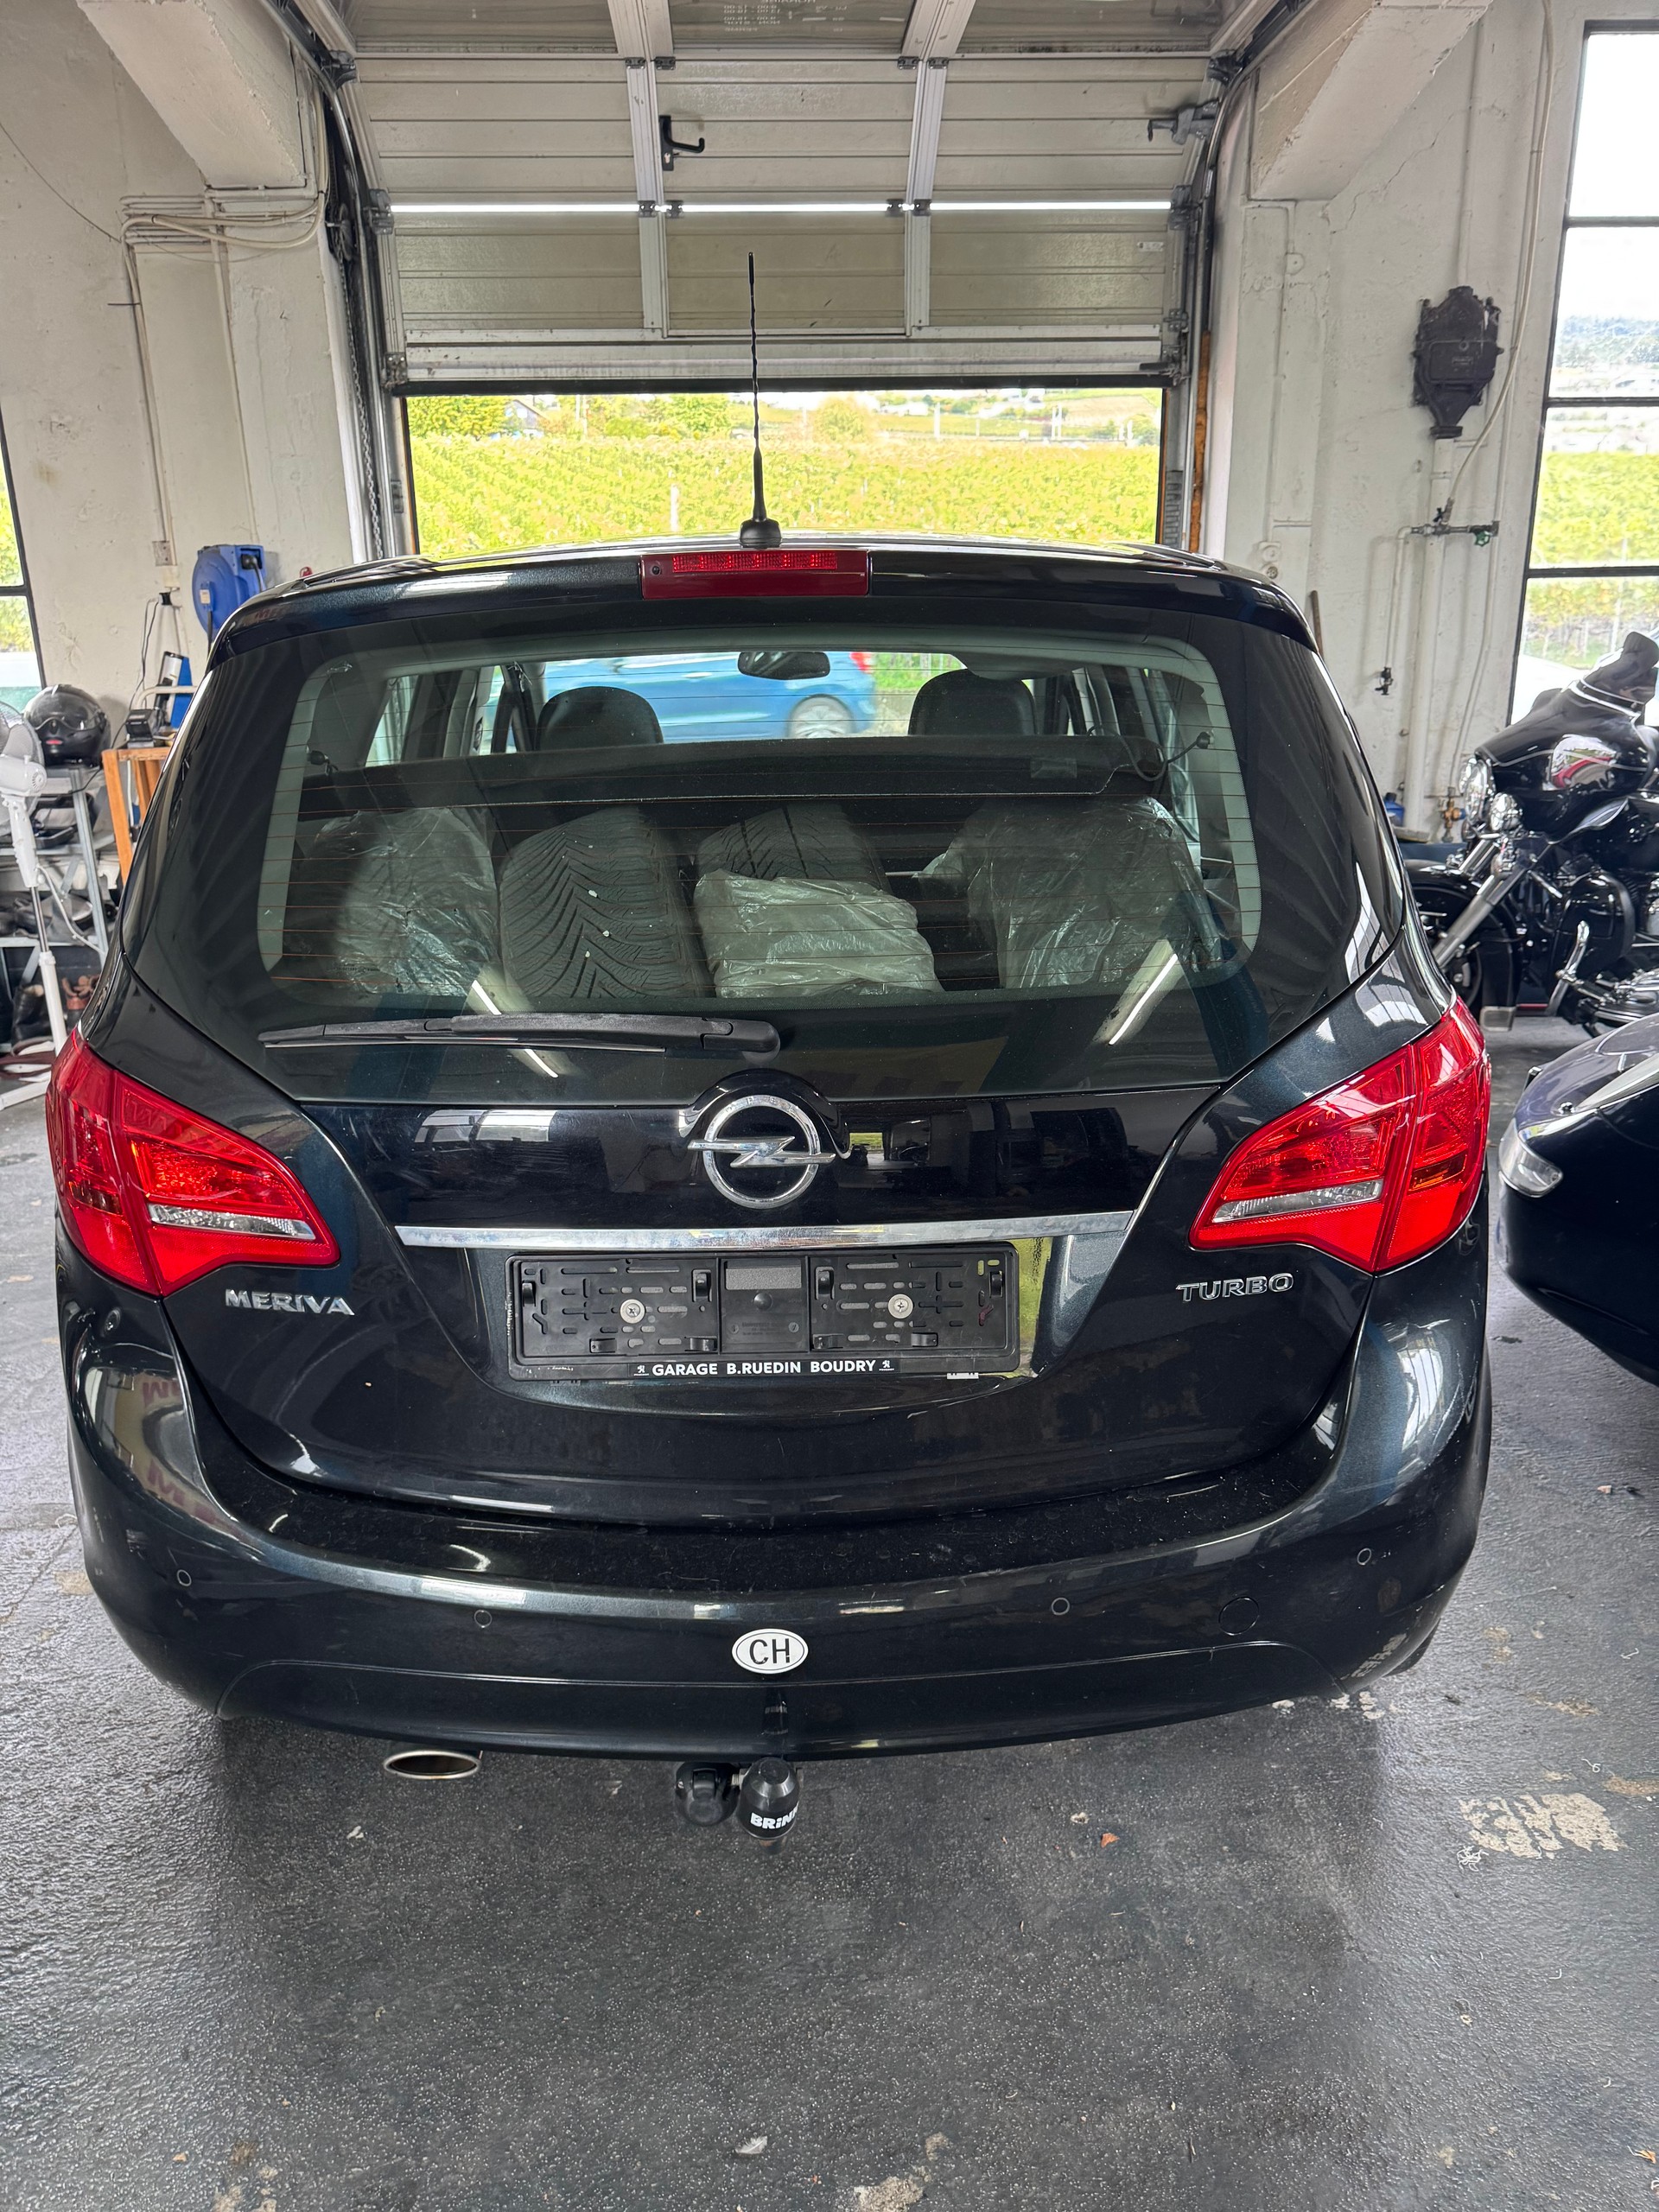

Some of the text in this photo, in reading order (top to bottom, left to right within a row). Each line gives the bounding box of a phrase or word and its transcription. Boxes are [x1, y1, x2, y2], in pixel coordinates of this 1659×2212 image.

[1176, 1273, 1294, 1301] TURBO
[225, 1289, 355, 1315] MERIVA
[652, 1359, 876, 1376] GARAGE B.RUEDIN BOUDRY
[749, 1638, 790, 1664] CH
